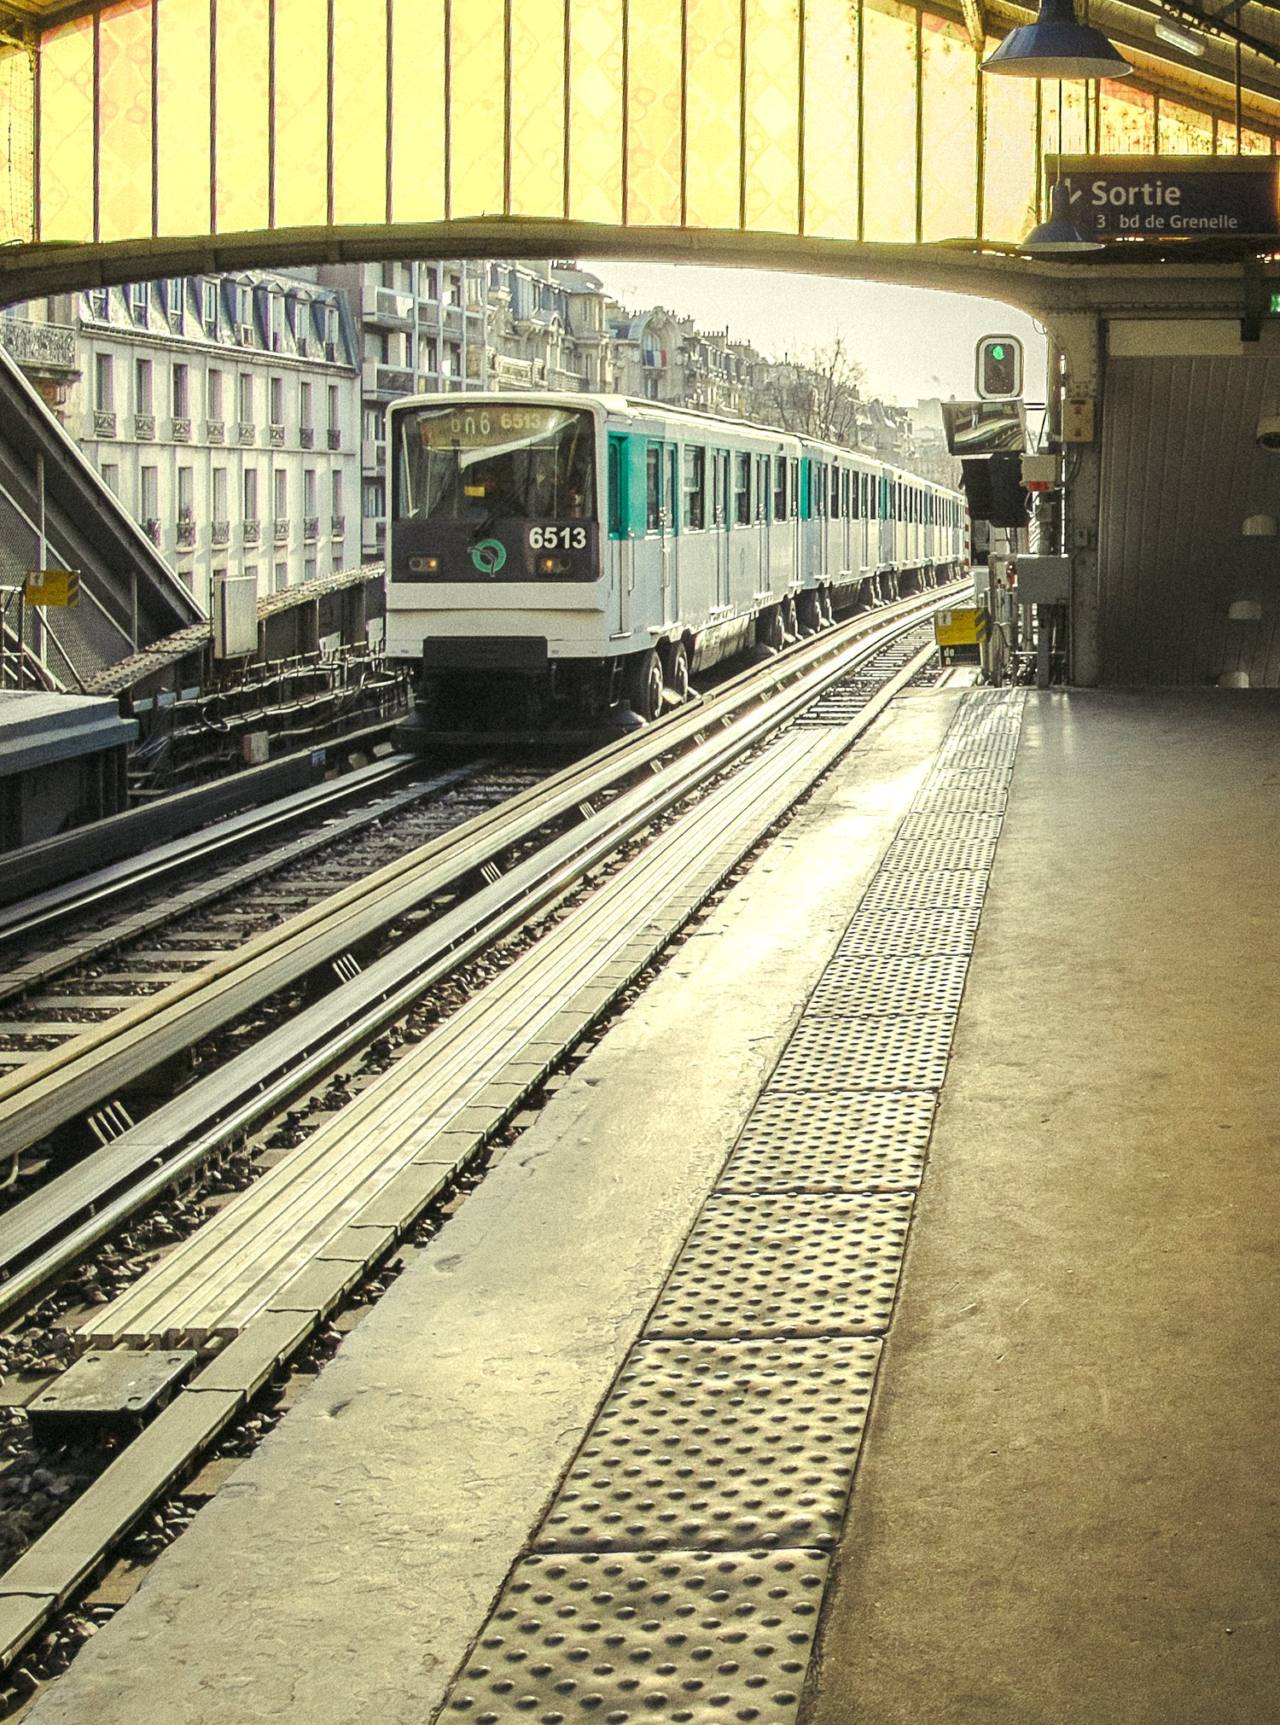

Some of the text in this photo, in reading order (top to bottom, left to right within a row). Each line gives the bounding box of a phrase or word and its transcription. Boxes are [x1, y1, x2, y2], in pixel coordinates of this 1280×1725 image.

[1091, 180, 1181, 206] Sortie
[1096, 214, 1239, 229] 3 bd de Grenelle
[501, 412, 541, 430] 6513
[529, 526, 587, 549] 6513
